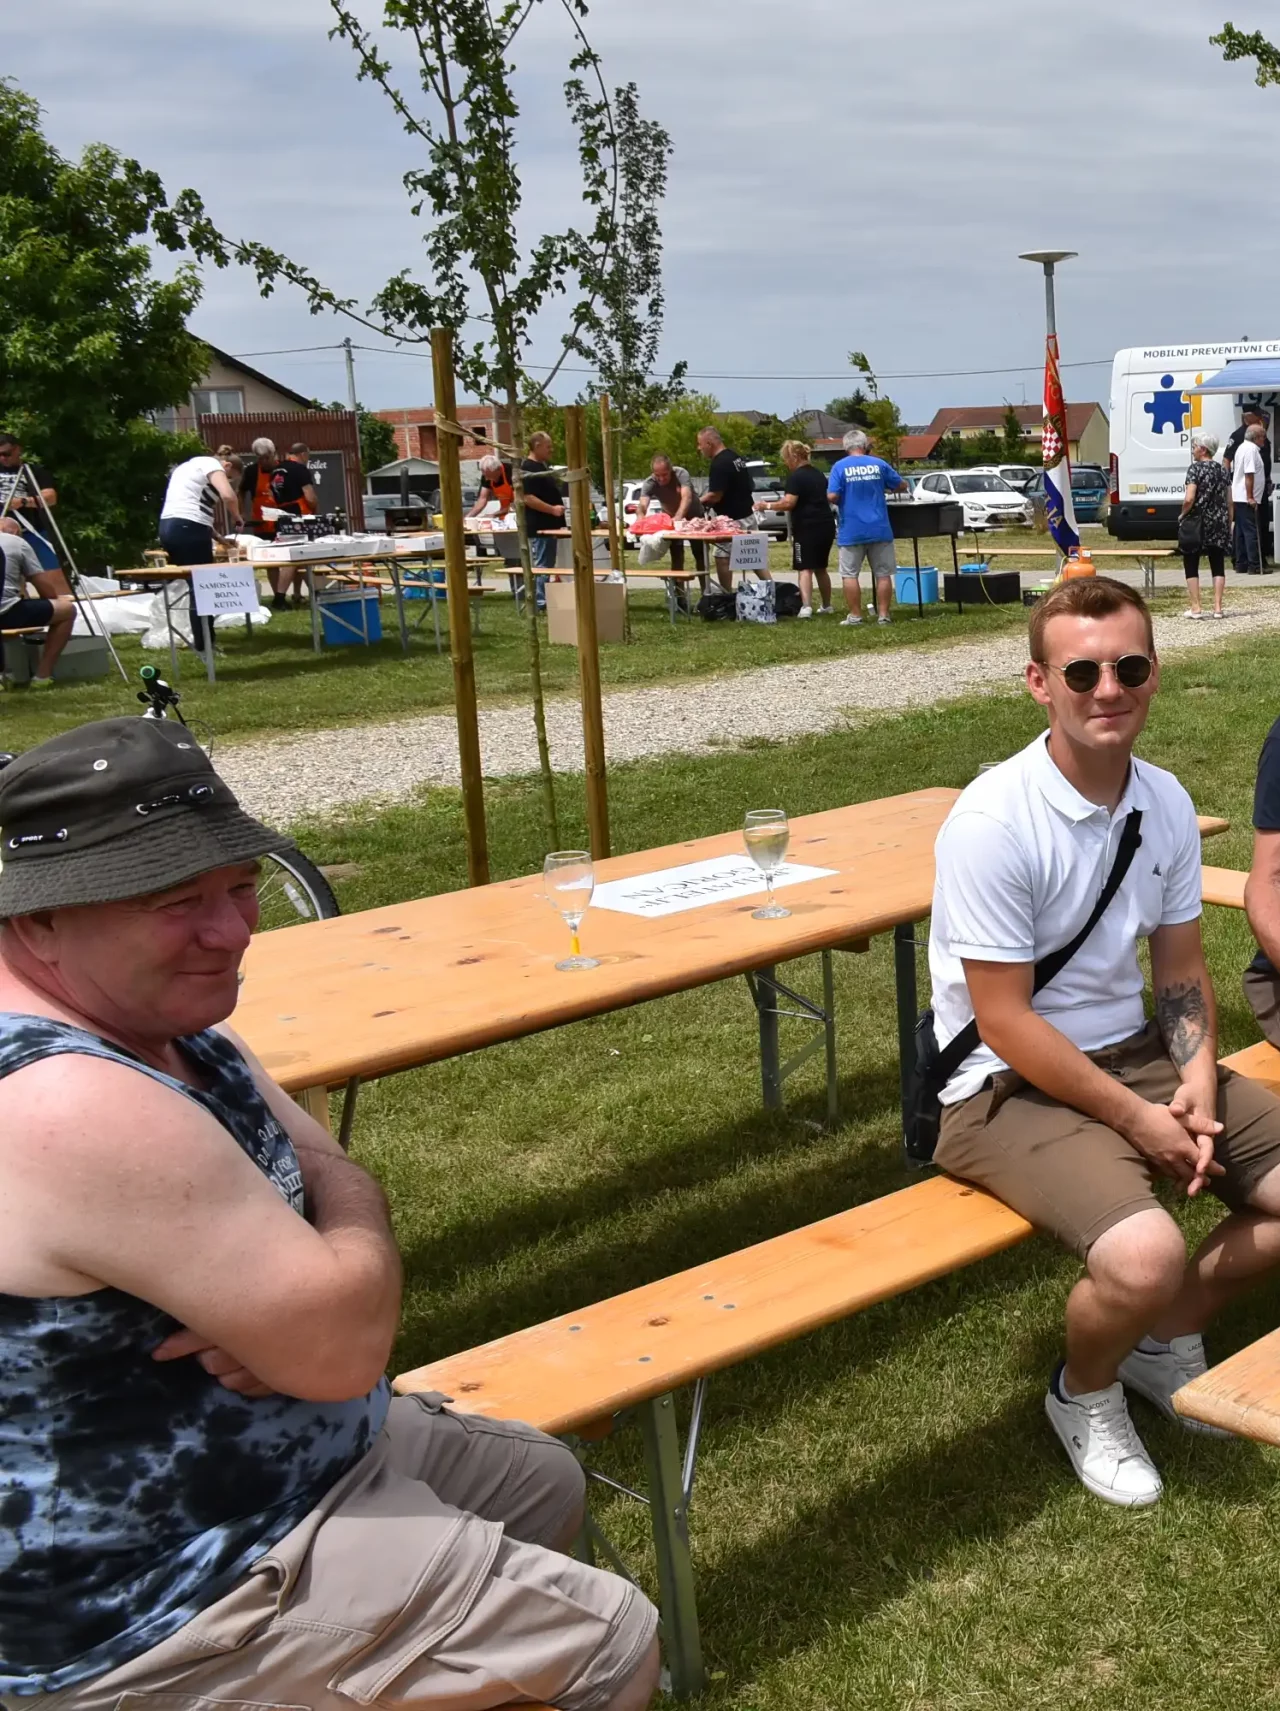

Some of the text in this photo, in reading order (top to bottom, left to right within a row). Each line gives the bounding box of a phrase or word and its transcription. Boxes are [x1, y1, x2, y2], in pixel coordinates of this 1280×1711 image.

[1143, 348, 1189, 359] MOBILNI
[1191, 344, 1263, 357] PREVENTIVNI
[844, 465, 880, 476] UHDDR
[740, 547, 759, 555] SVETA
[735, 557, 762, 565] NEDELJA
[199, 581, 250, 590] SAMOSTALNA
[214, 591, 240, 599] BOJNA
[213, 600, 243, 609] KUTINA
